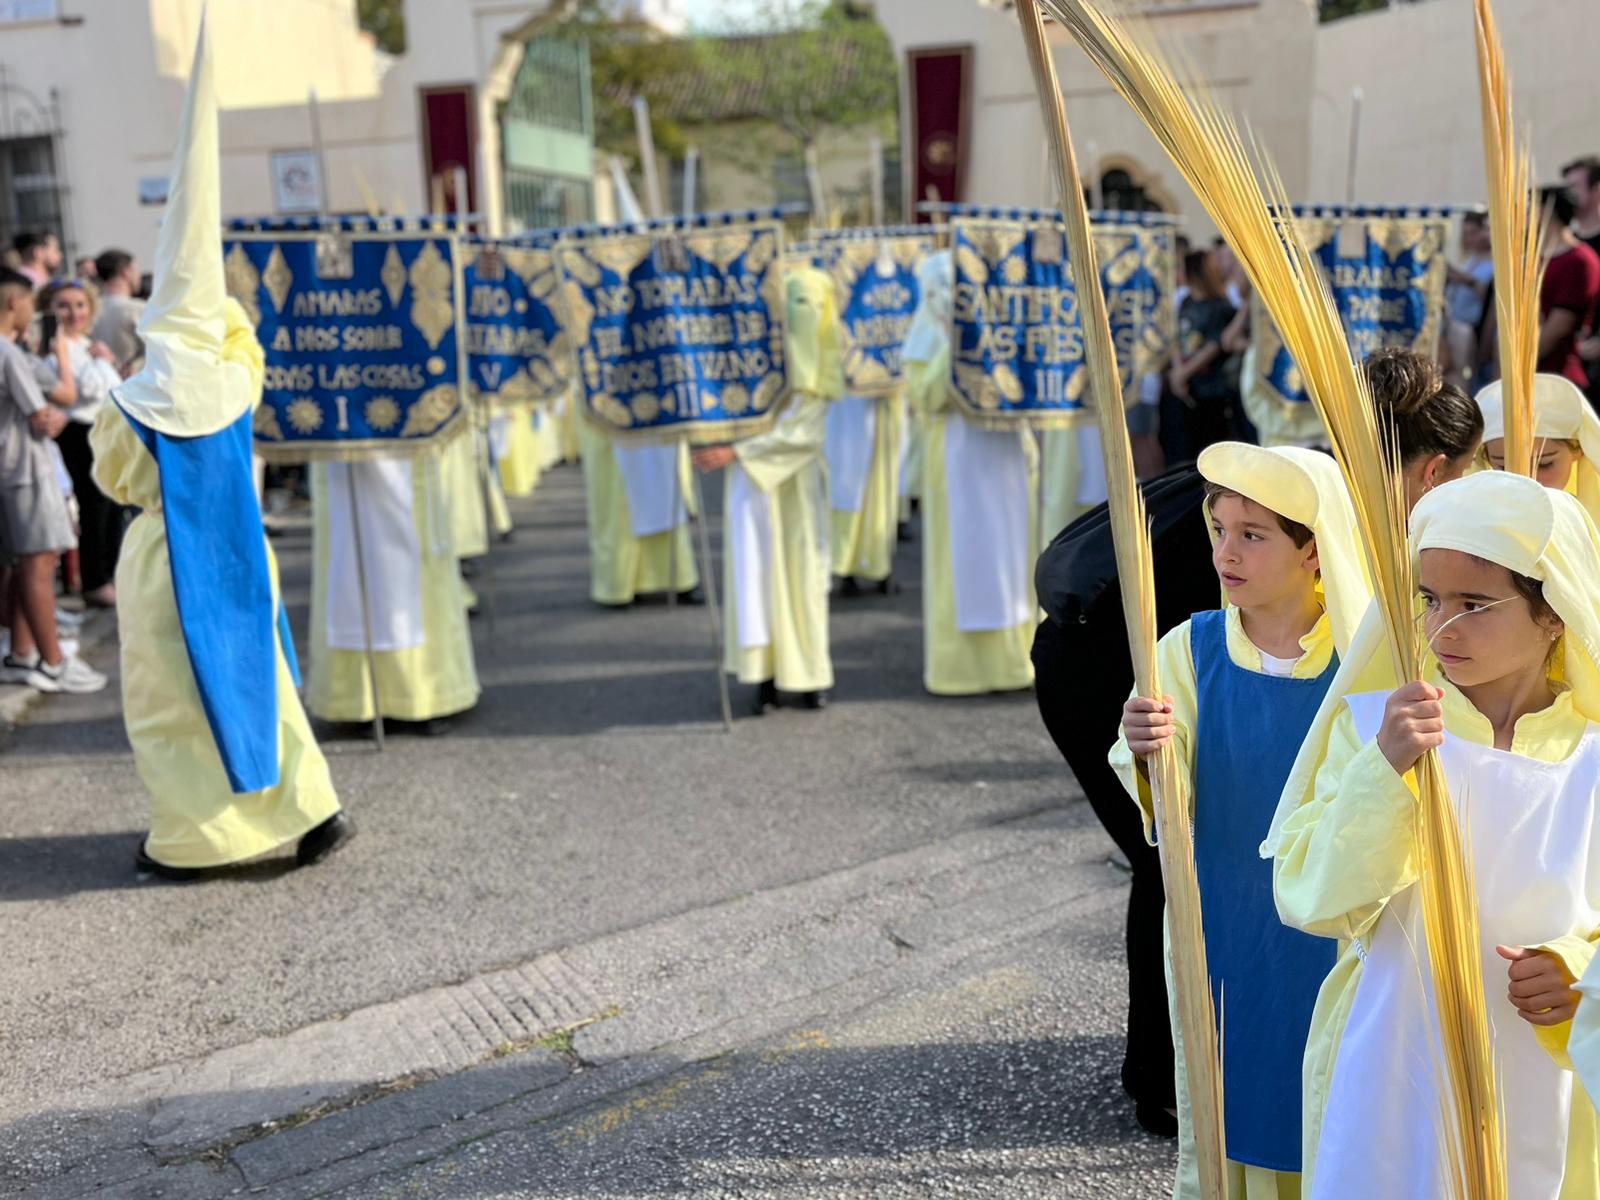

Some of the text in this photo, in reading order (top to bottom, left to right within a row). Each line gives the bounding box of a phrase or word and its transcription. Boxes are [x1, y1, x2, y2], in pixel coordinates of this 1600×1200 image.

[293, 288, 382, 317] AMARAS
[470, 284, 511, 317] NO
[594, 275, 759, 317] NO TOMARAS
[271, 323, 402, 351] A DIOS SOBRE
[594, 310, 766, 358] EL NOMBRE DE
[953, 325, 1018, 360] LAS
[263, 363, 425, 391] ODAS LAS COSAS
[479, 361, 502, 390] V
[603, 349, 770, 393] DIOS EN VANO
[1036, 369, 1063, 402] III
[335, 395, 349, 432] I
[675, 382, 701, 417] II
